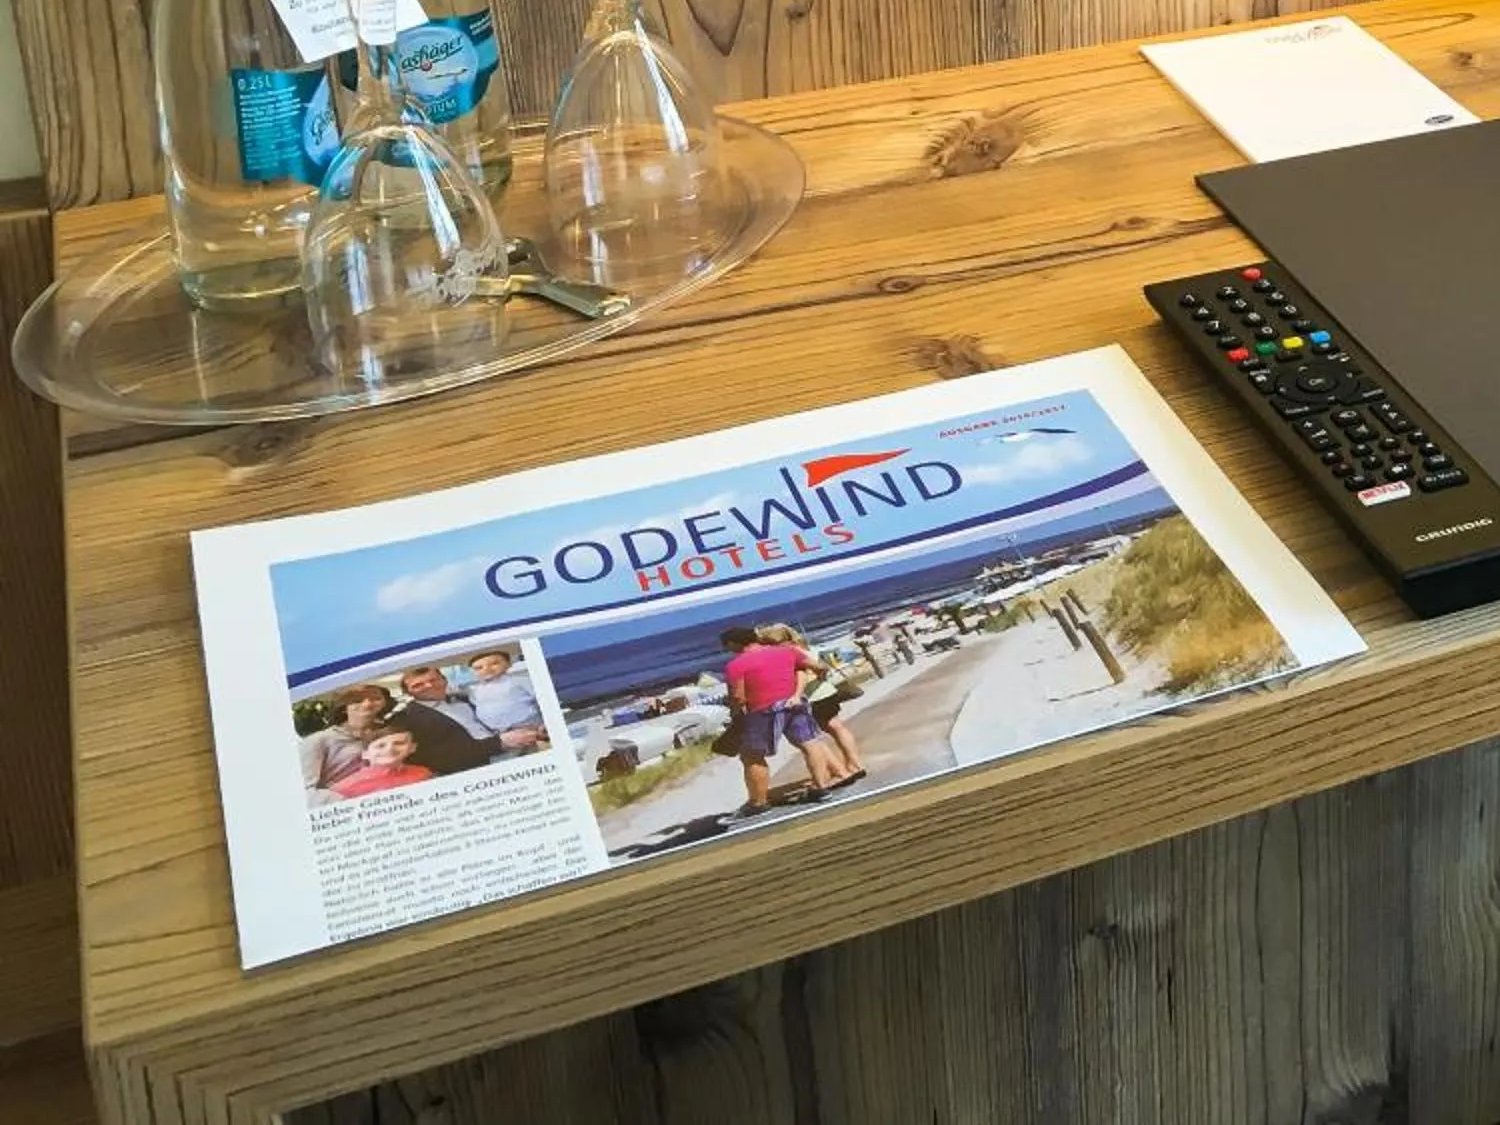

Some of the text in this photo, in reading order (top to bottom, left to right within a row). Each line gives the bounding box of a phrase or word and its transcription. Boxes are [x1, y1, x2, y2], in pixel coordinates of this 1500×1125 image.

[401, 36, 464, 70] ashäger
[485, 461, 964, 599] GODEWIND
[635, 522, 856, 591] HOTELS
[1415, 517, 1493, 543] GRUNDIG
[357, 798, 424, 823] Freunde
[428, 789, 458, 805] des
[463, 763, 556, 794] GODEWIND
